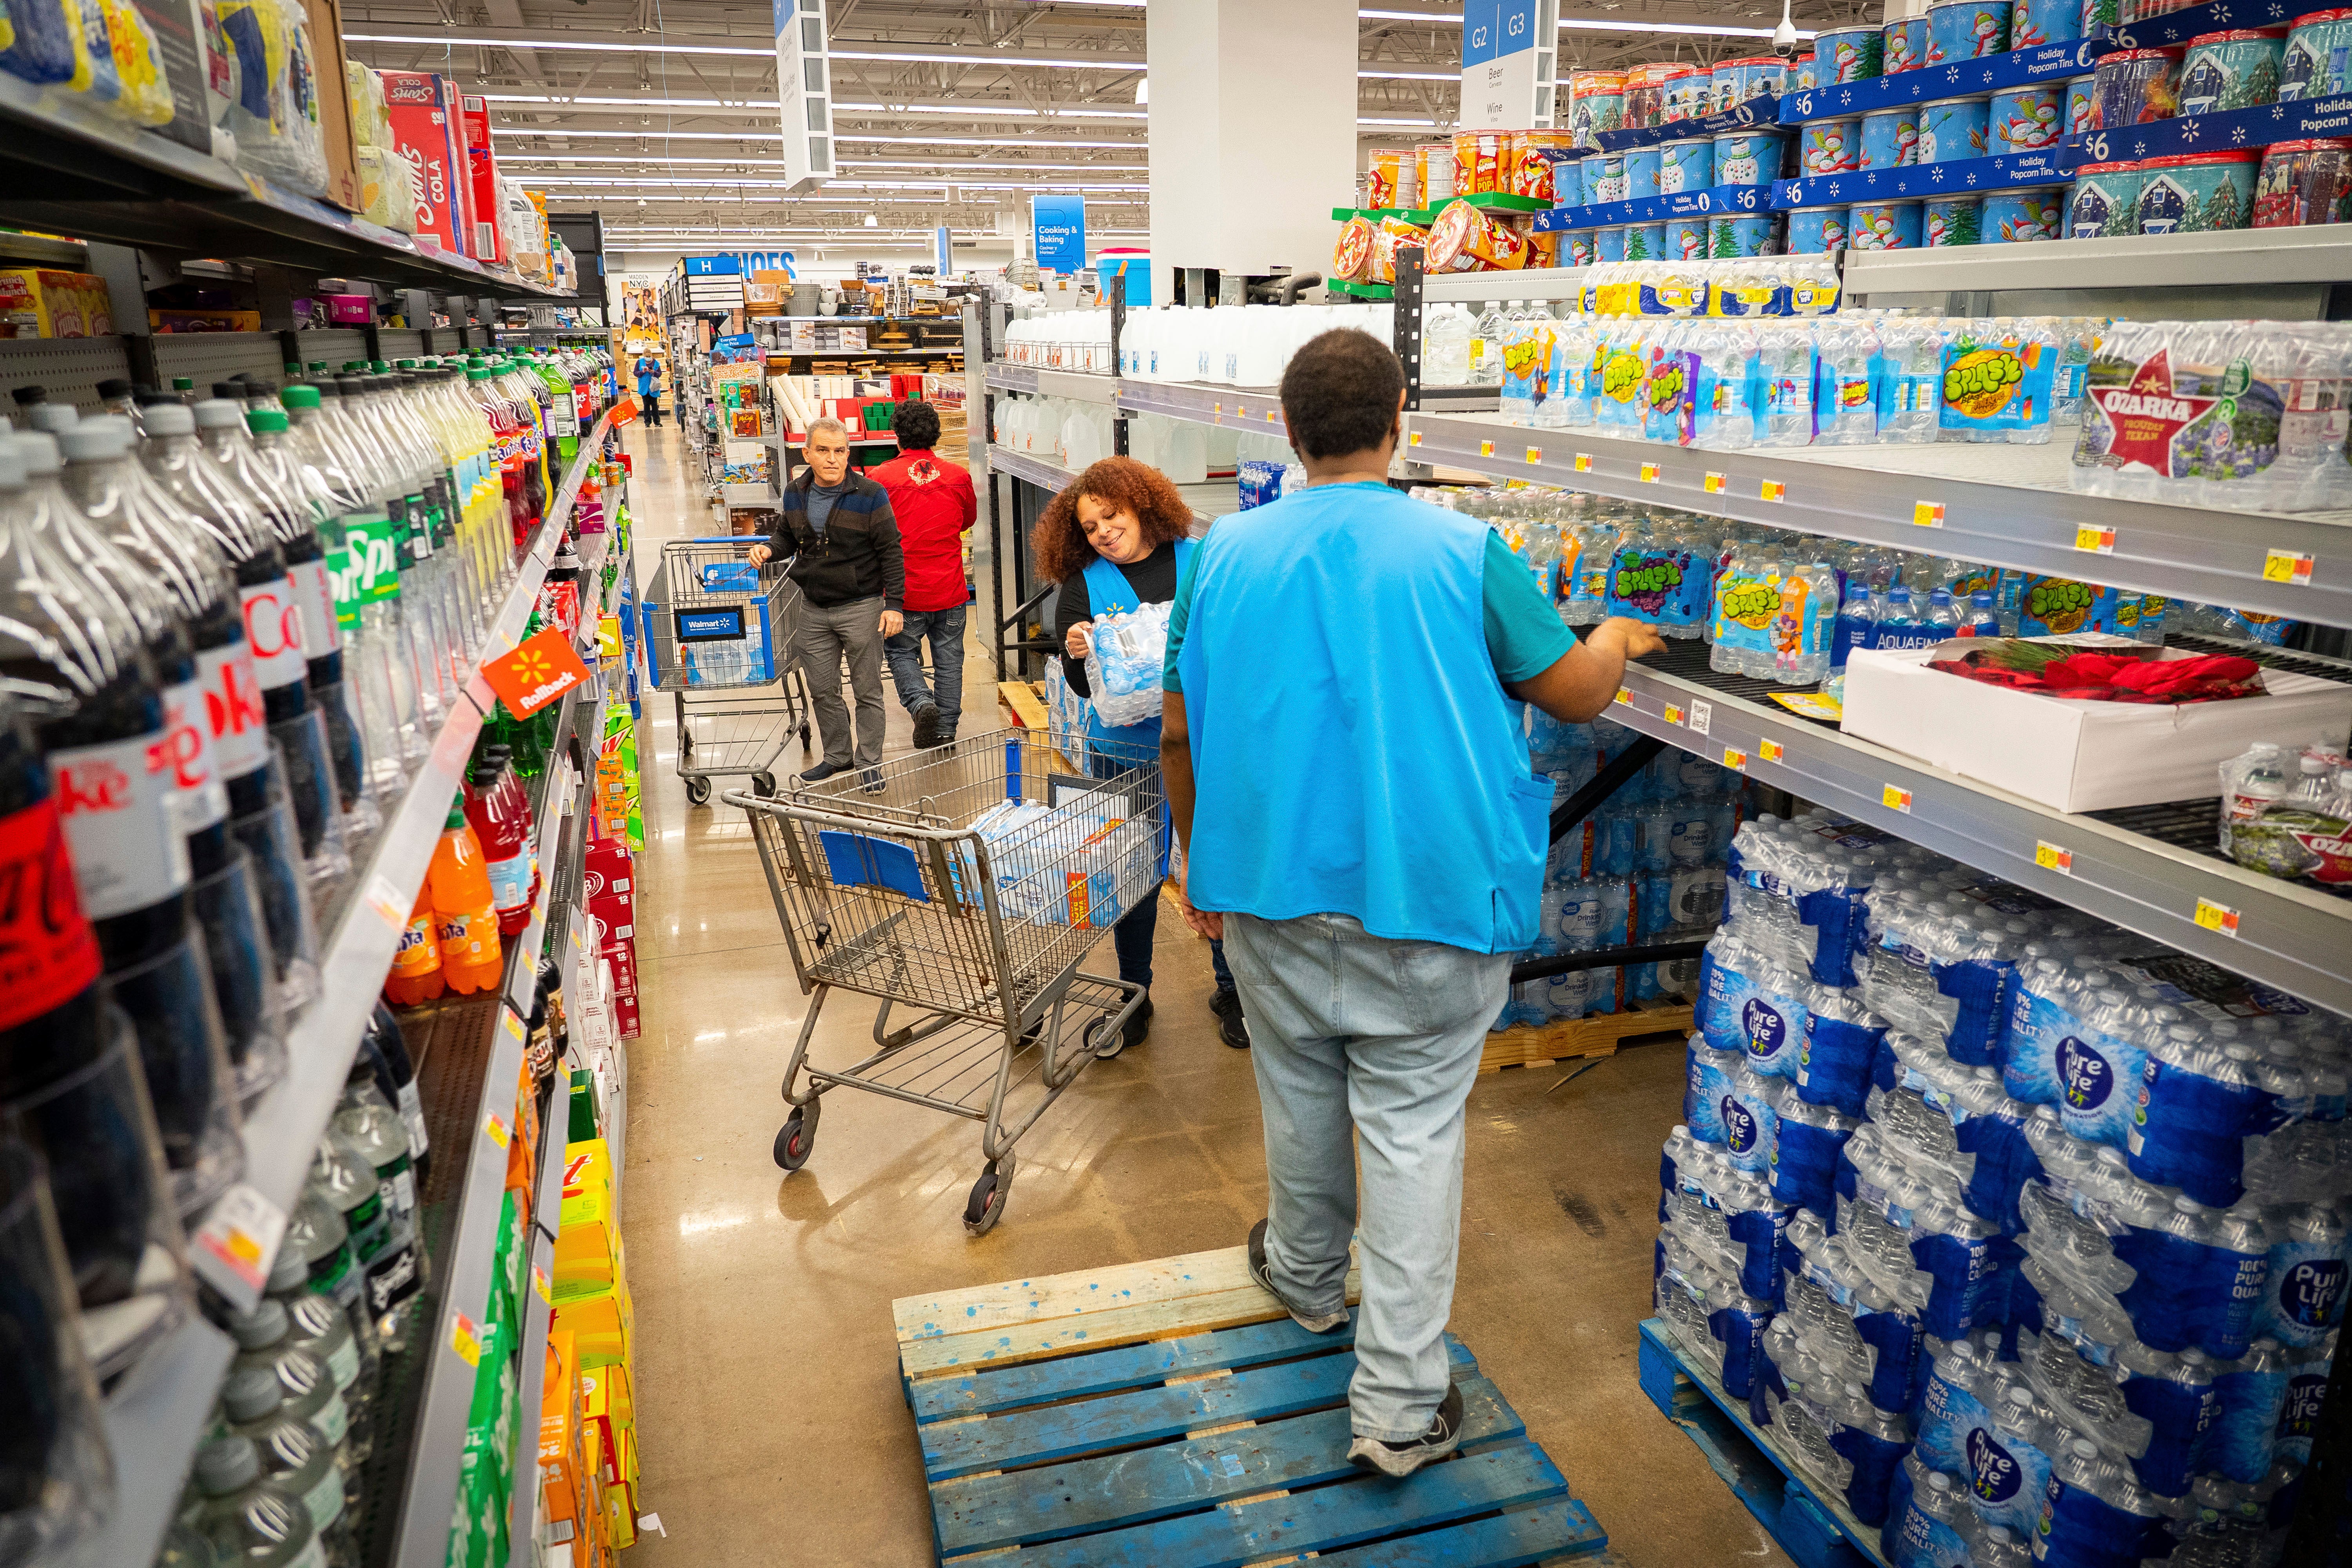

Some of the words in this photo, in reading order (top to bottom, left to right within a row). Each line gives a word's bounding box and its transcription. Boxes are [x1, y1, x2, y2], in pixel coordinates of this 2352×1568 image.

[1508, 13, 1524, 36] G3
[1473, 26, 1487, 48] G2
[2108, 27, 2138, 49] $6
[2038, 48, 2065, 60] Holiday
[1489, 68, 1503, 80] Beer
[2028, 61, 2057, 74] Popcorn
[2057, 59, 2073, 69] Tins
[1487, 102, 1502, 114] Wine
[1797, 93, 1812, 115] $6
[2315, 99, 2352, 113] Holida
[431, 112, 445, 125] 12
[1706, 113, 1726, 122] Holiday
[2301, 116, 2348, 131] Popcorn
[1704, 121, 1724, 131] Popcorn
[1529, 136, 1550, 149] Cheetos
[2086, 132, 2109, 160] $6
[2019, 157, 2046, 167] Holiday
[430, 159, 444, 203] COLA
[2010, 169, 2037, 180] Popcorn
[2038, 167, 2054, 176] Tins
[1477, 181, 1495, 192] POP!
[1786, 182, 1802, 203] $6
[1737, 189, 1756, 209] $6
[1672, 205, 1689, 213] Popcorn
[1537, 213, 1550, 229] $6
[1039, 226, 1069, 235] Cooking
[1040, 235, 1064, 244] Baking
[701, 261, 711, 272] H
[629, 280, 649, 289] NYC
[1944, 352, 2022, 401] SPLASH
[2105, 392, 2190, 421] OZARKA
[617, 416, 634, 426] Rollback
[1617, 562, 1681, 597] SPLASH
[2031, 583, 2091, 616] SPLASH
[688, 620, 719, 628] Walmart
[520, 672, 576, 710] Rollback
[1577, 913, 1601, 922] Drinking
[1749, 1000, 1778, 1029] Pure
[1749, 1019, 1772, 1041] Life
[2065, 1038, 2103, 1074] Pure
[1969, 1258, 1989, 1270] PUR
[1975, 1430, 2011, 1473] Pure
[1975, 1449, 2002, 1486] Life
[1905, 1515, 1929, 1539] PURE
